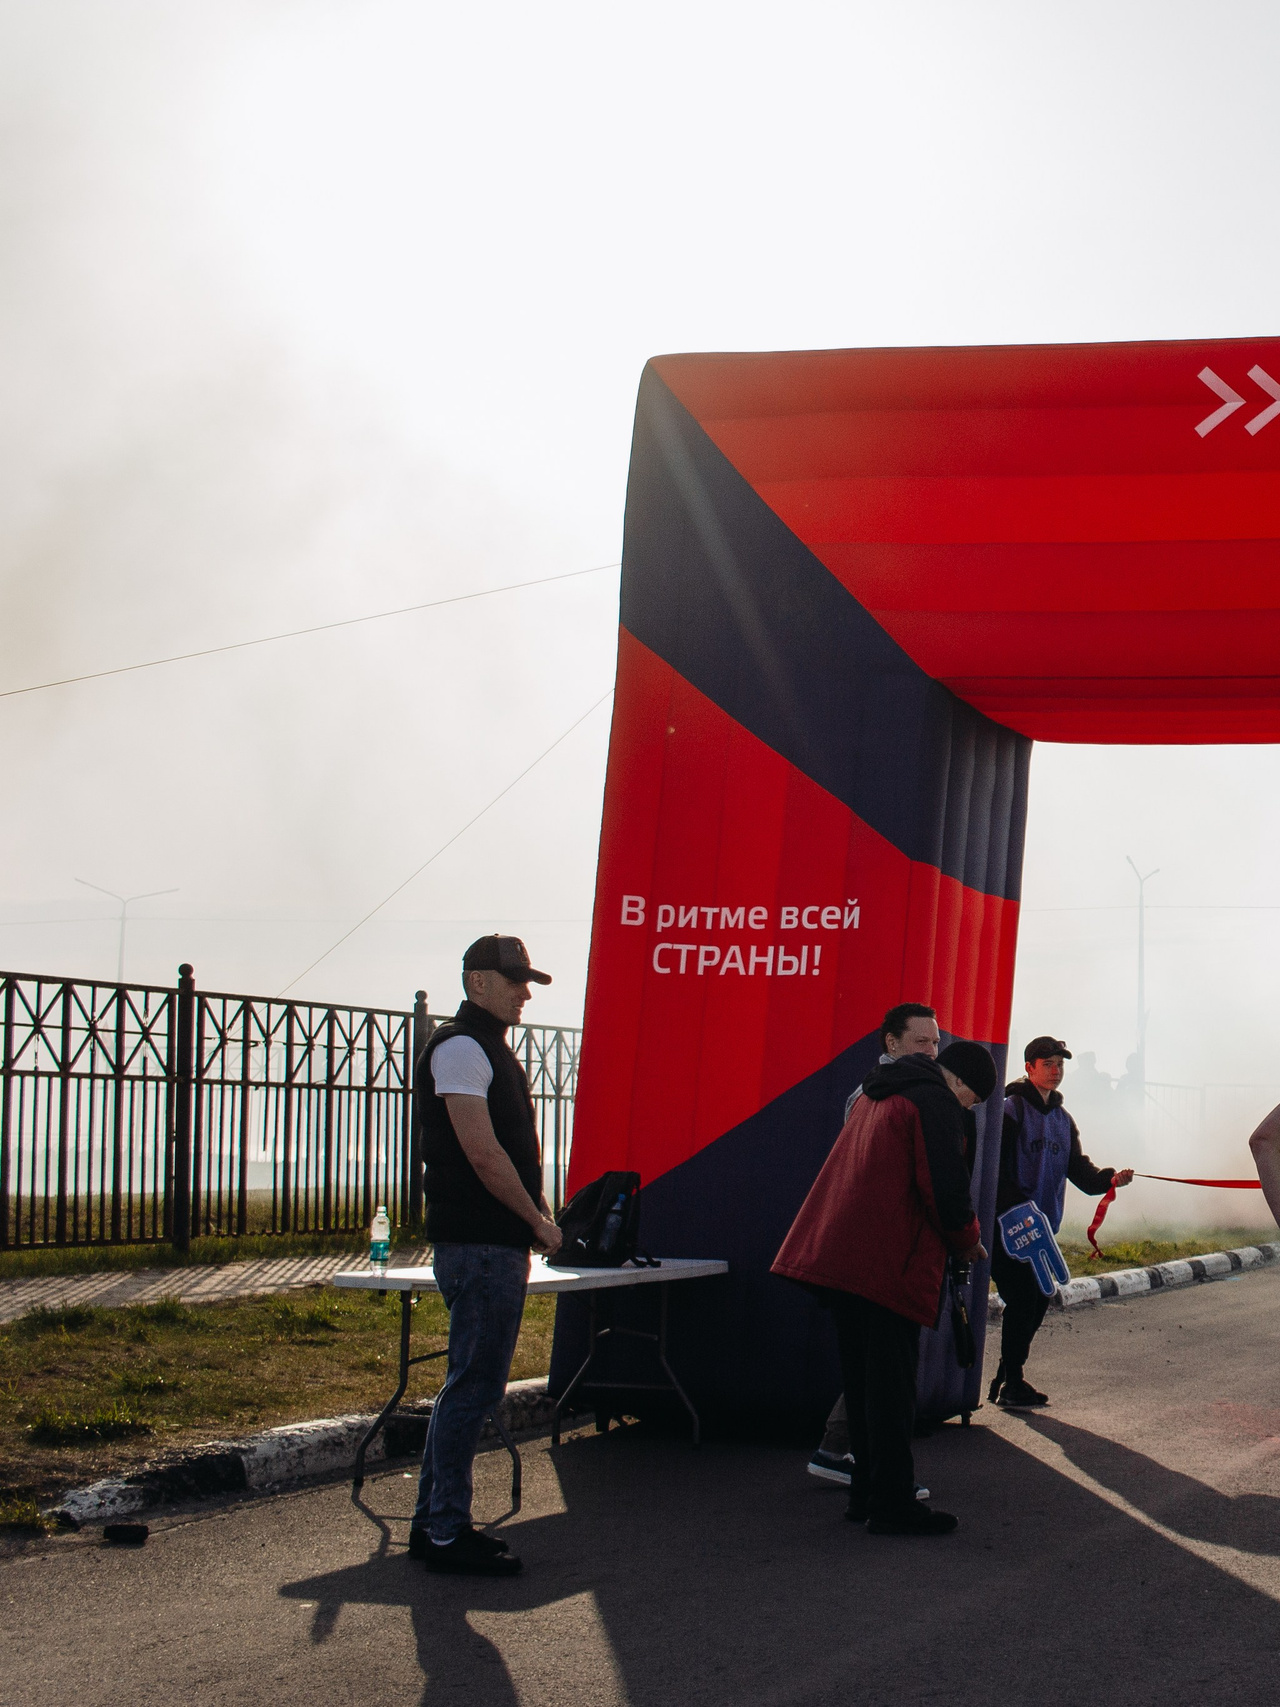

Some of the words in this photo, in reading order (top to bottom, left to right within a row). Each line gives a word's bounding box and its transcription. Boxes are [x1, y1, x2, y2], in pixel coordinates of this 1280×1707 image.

[620, 895, 646, 926] В
[656, 904, 768, 933] ритме
[780, 898, 861, 930] всей
[653, 943, 822, 976] СТРАНЫ!
